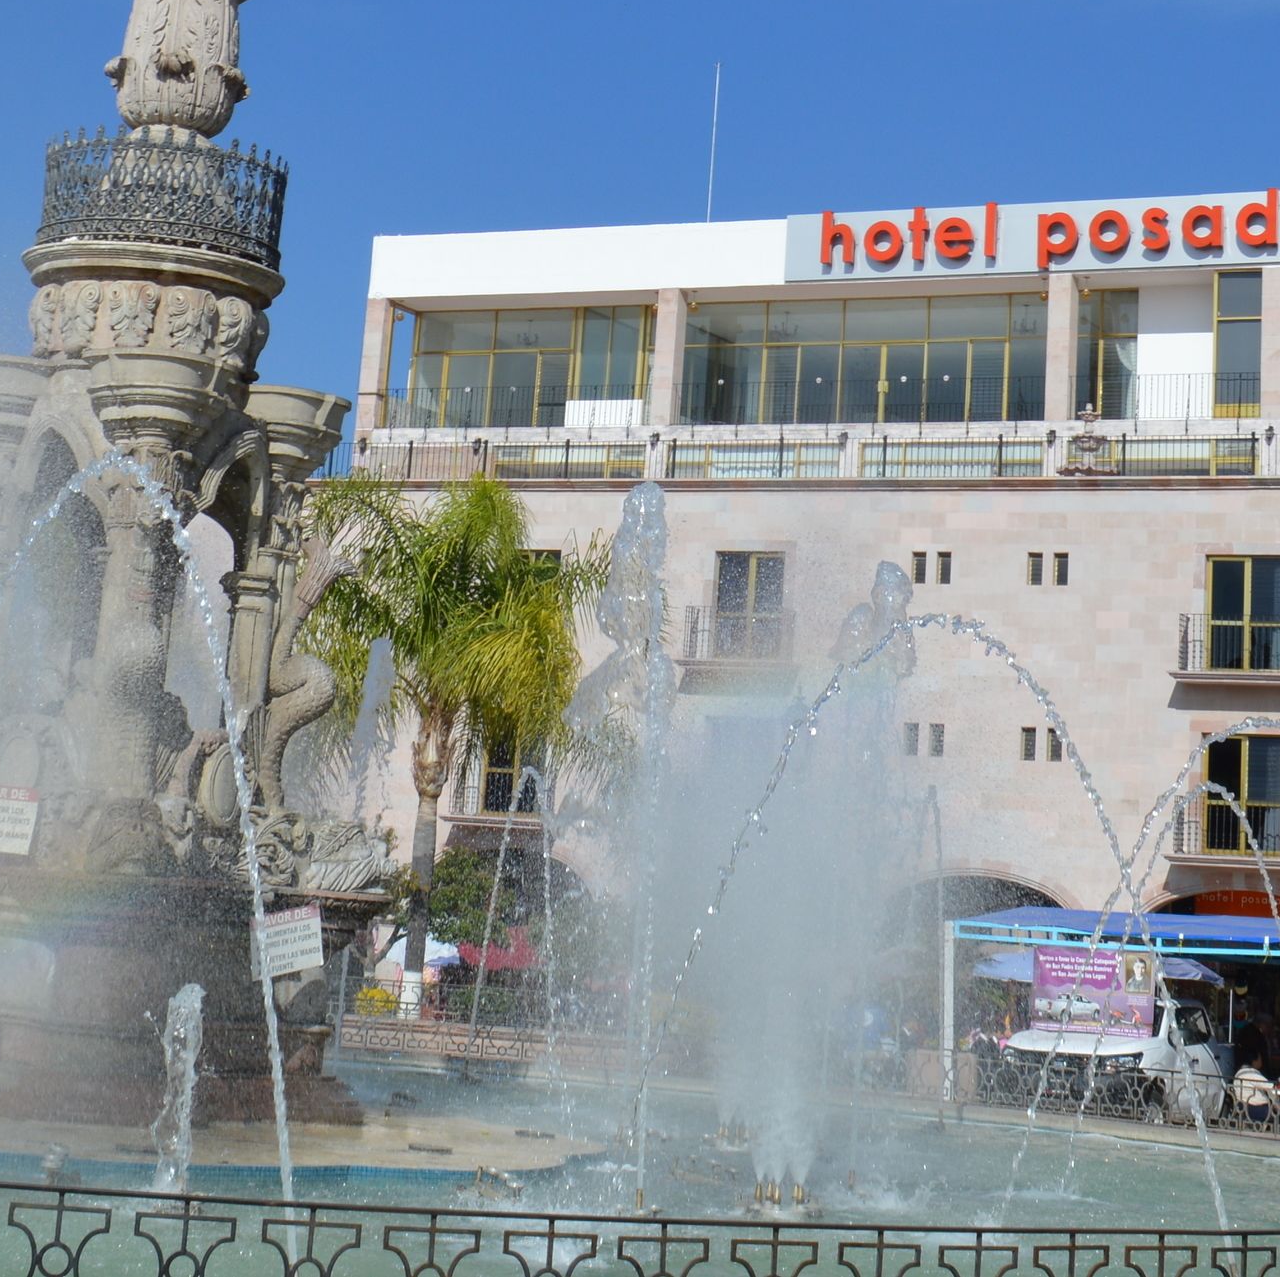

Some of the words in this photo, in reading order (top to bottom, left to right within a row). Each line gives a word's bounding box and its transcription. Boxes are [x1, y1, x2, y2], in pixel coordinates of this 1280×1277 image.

[821, 201, 999, 265] hotel
[10, 788, 30, 801] DE:
[1241, 895, 1280, 908] posaa
[294, 908, 311, 920] DE:
